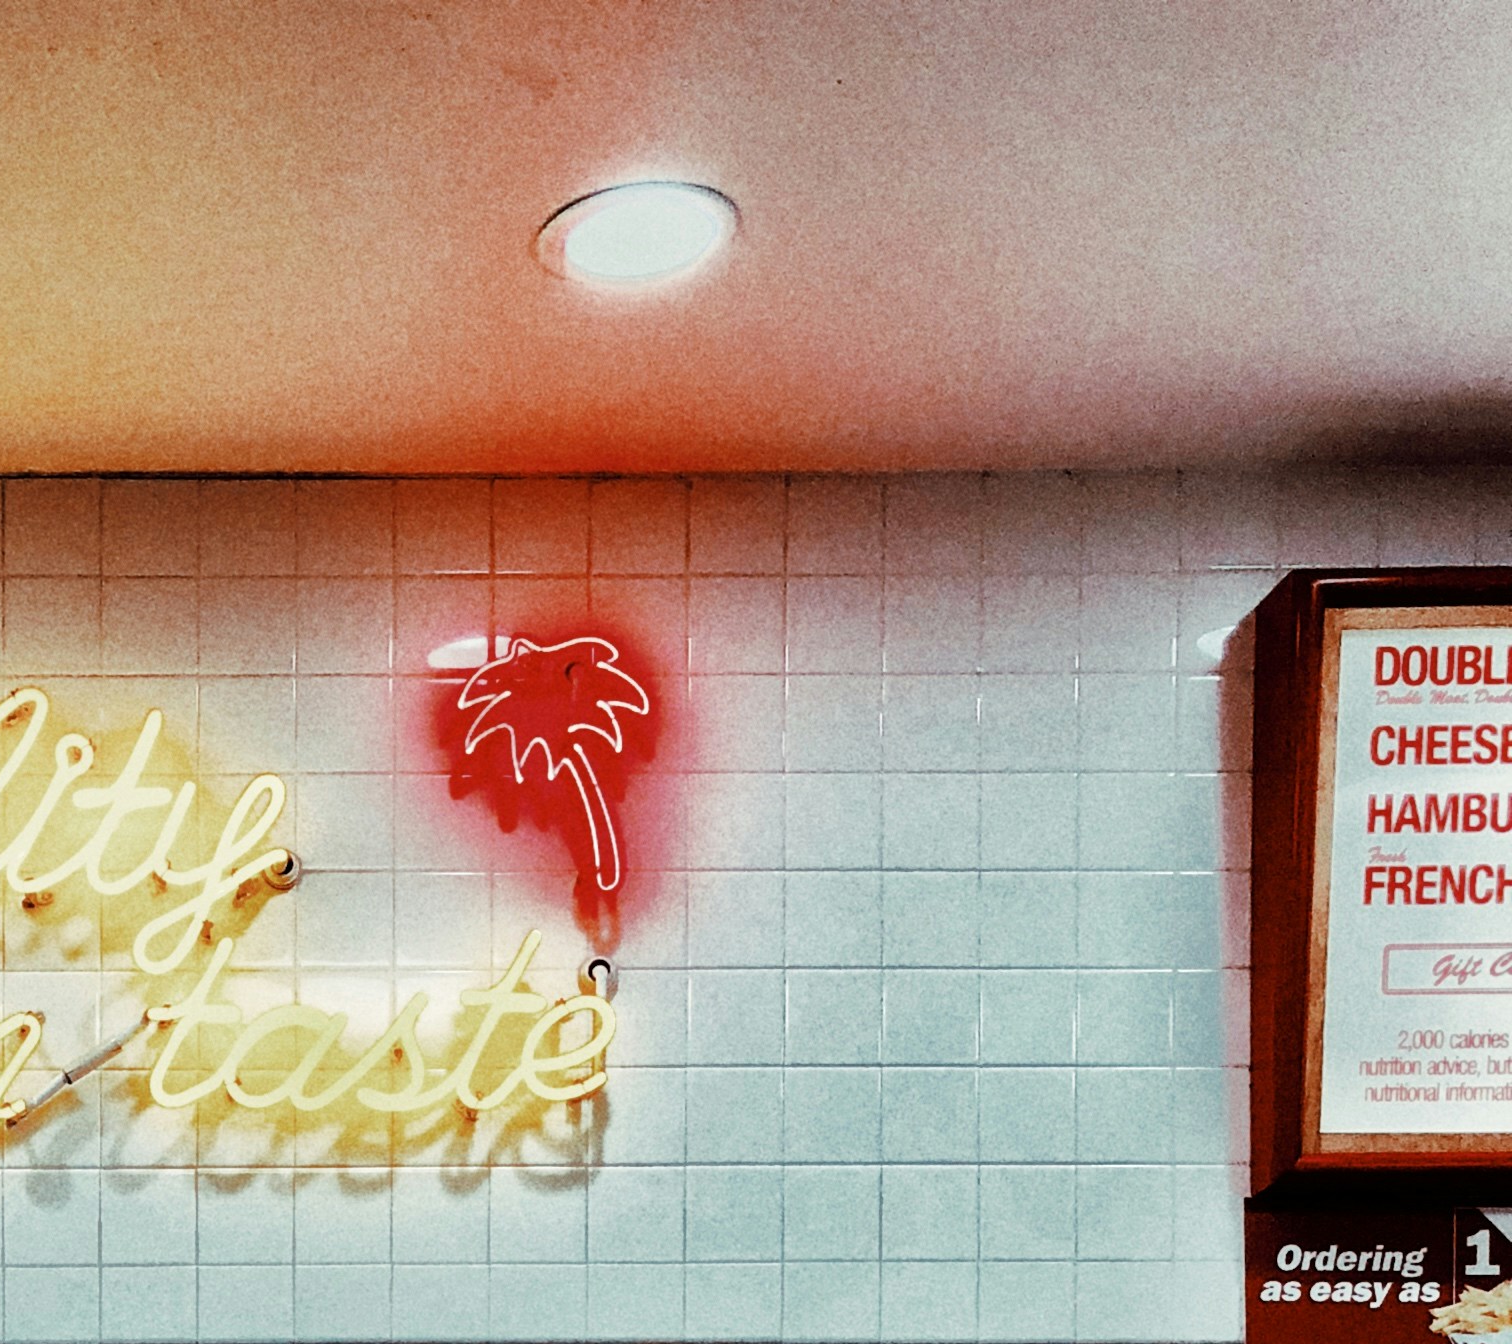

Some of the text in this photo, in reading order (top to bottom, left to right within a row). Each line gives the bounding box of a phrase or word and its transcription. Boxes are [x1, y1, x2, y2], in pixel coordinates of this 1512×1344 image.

[1375, 645, 1512, 686] DOUBL
[1367, 793, 1512, 833] HAMBU
[1368, 846, 1407, 863] Fresh
[1363, 864, 1512, 905] FRENCH
[1432, 954, 1482, 986] Gift
[144, 928, 618, 1114] taste
[1398, 1028, 1510, 1051] 2,000 calories
[1359, 1055, 1422, 1076] nutrition
[1426, 1054, 1480, 1077] advice,
[1364, 1082, 1440, 1102] nutritional
[1276, 1244, 1428, 1277] Ordering
[1465, 1229, 1500, 1275] 1
[1260, 1280, 1441, 1309] as easy as
